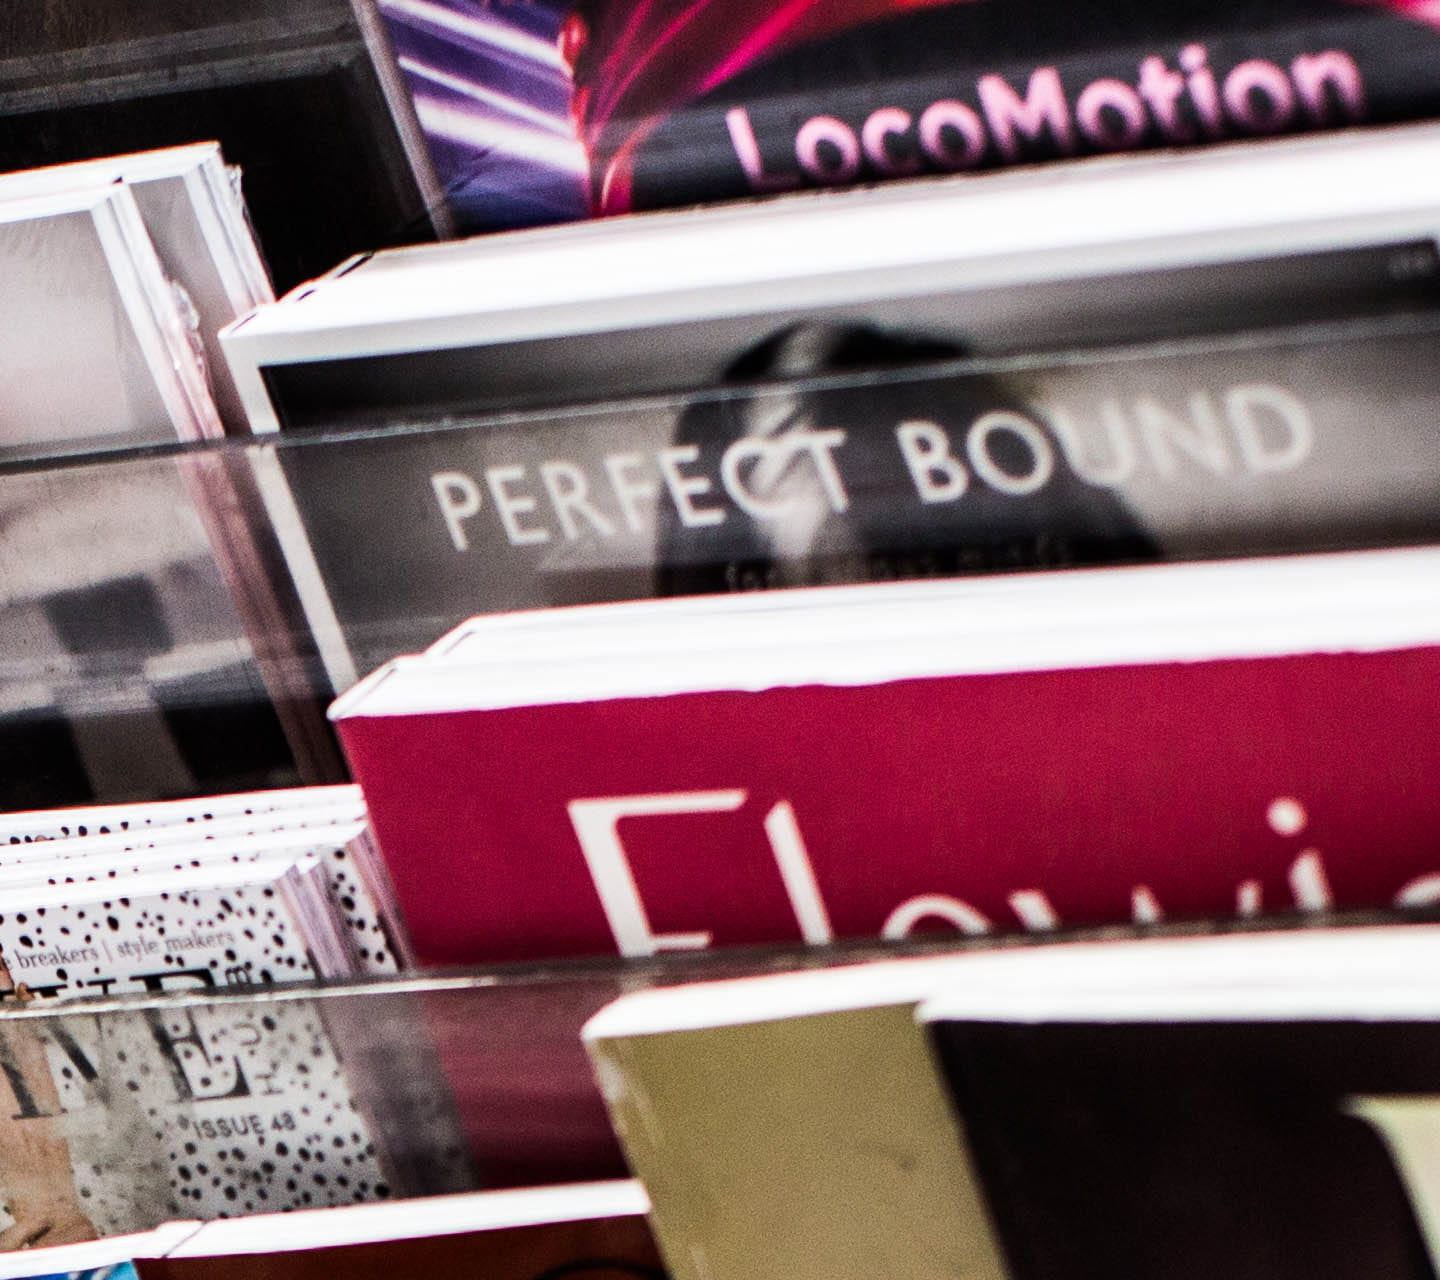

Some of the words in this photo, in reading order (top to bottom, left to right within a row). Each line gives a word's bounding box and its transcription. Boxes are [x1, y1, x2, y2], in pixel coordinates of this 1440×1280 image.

[724, 43, 1365, 192] LocoMotion
[431, 428, 853, 552] PERFECT
[894, 384, 1314, 508] BOUND
[15, 942, 100, 971] breakers
[116, 936, 161, 963] style
[165, 928, 236, 953] makers
[193, 1115, 266, 1140] ISSUE
